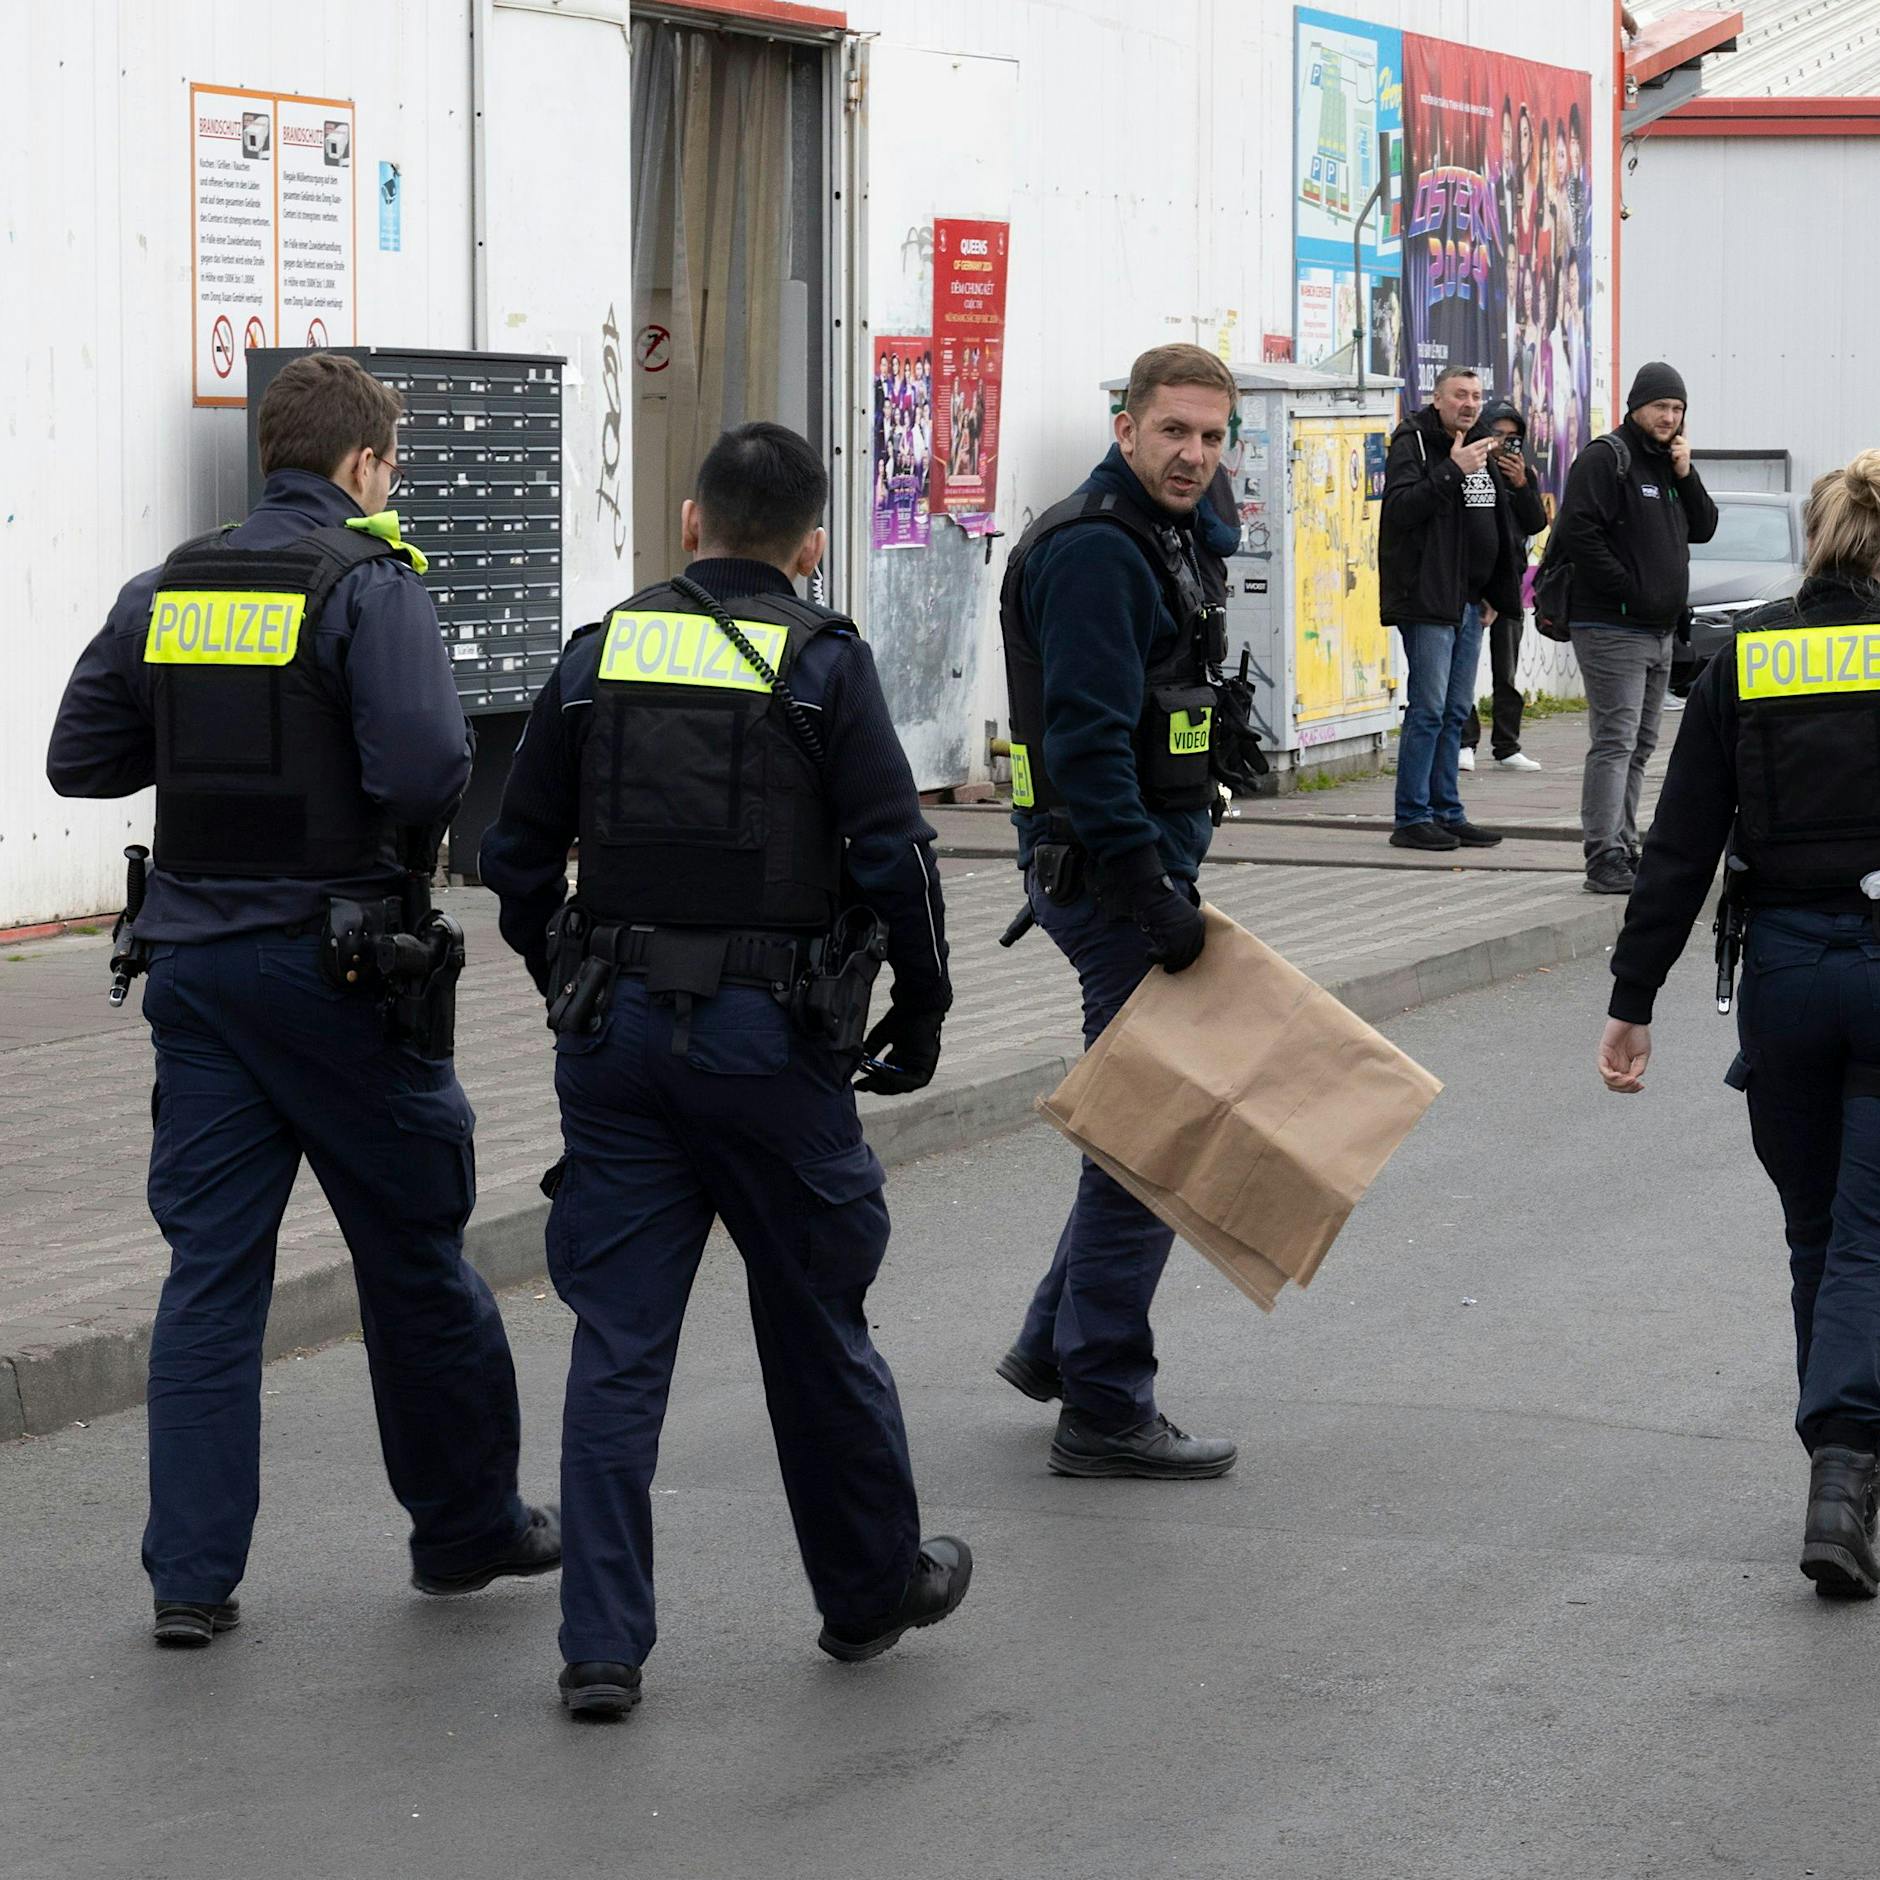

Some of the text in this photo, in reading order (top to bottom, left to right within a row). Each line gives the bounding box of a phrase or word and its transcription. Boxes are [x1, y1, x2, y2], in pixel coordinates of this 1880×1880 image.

[199, 117, 241, 136] BRANDSCHUTZ
[283, 126, 323, 144] BRANDSCHUTZ
[1408, 165, 1504, 259] OSTERN
[960, 238, 988, 256] QUEENS
[1427, 237, 1489, 309] 2024
[155, 603, 294, 654] POLIZEI
[606, 618, 781, 685] POLIZEI
[1174, 731, 1207, 750] VIDEO
